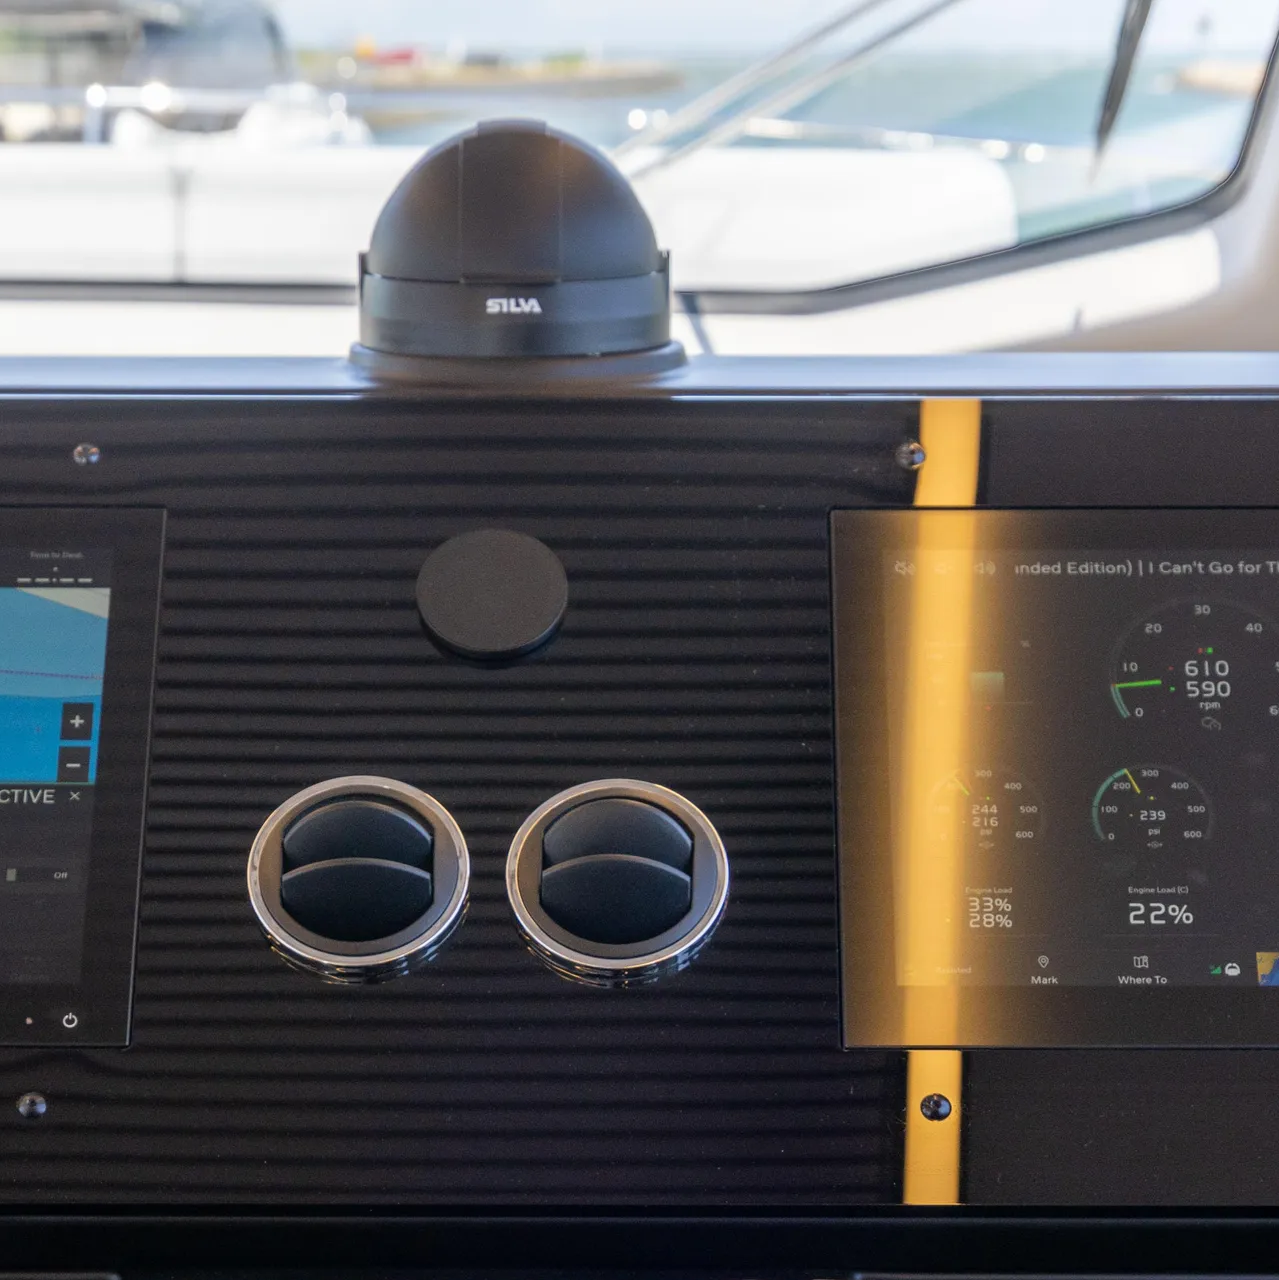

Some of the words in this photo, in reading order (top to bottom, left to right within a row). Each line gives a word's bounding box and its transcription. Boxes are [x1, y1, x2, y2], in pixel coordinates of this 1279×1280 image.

[486, 298, 542, 314] SILVA
[1067, 560, 1133, 576] Edition)
[1159, 561, 1204, 574] Can't
[1209, 561, 1234, 574] Go
[1238, 560, 1262, 574] for
[1185, 661, 1229, 676] 610
[1186, 681, 1231, 697] 590
[1200, 701, 1220, 710] rpm
[972, 805, 998, 814] 244
[1140, 810, 1166, 821] 239
[972, 817, 998, 827] 216
[1148, 828, 1161, 836] psi
[1128, 887, 1155, 895] Engine
[968, 898, 1012, 912] 33%
[1129, 903, 1193, 924] 22%
[968, 914, 1013, 928] 28%
[1031, 976, 1058, 984] Mark
[1118, 976, 1151, 984] Where
[1154, 976, 1167, 984] To
